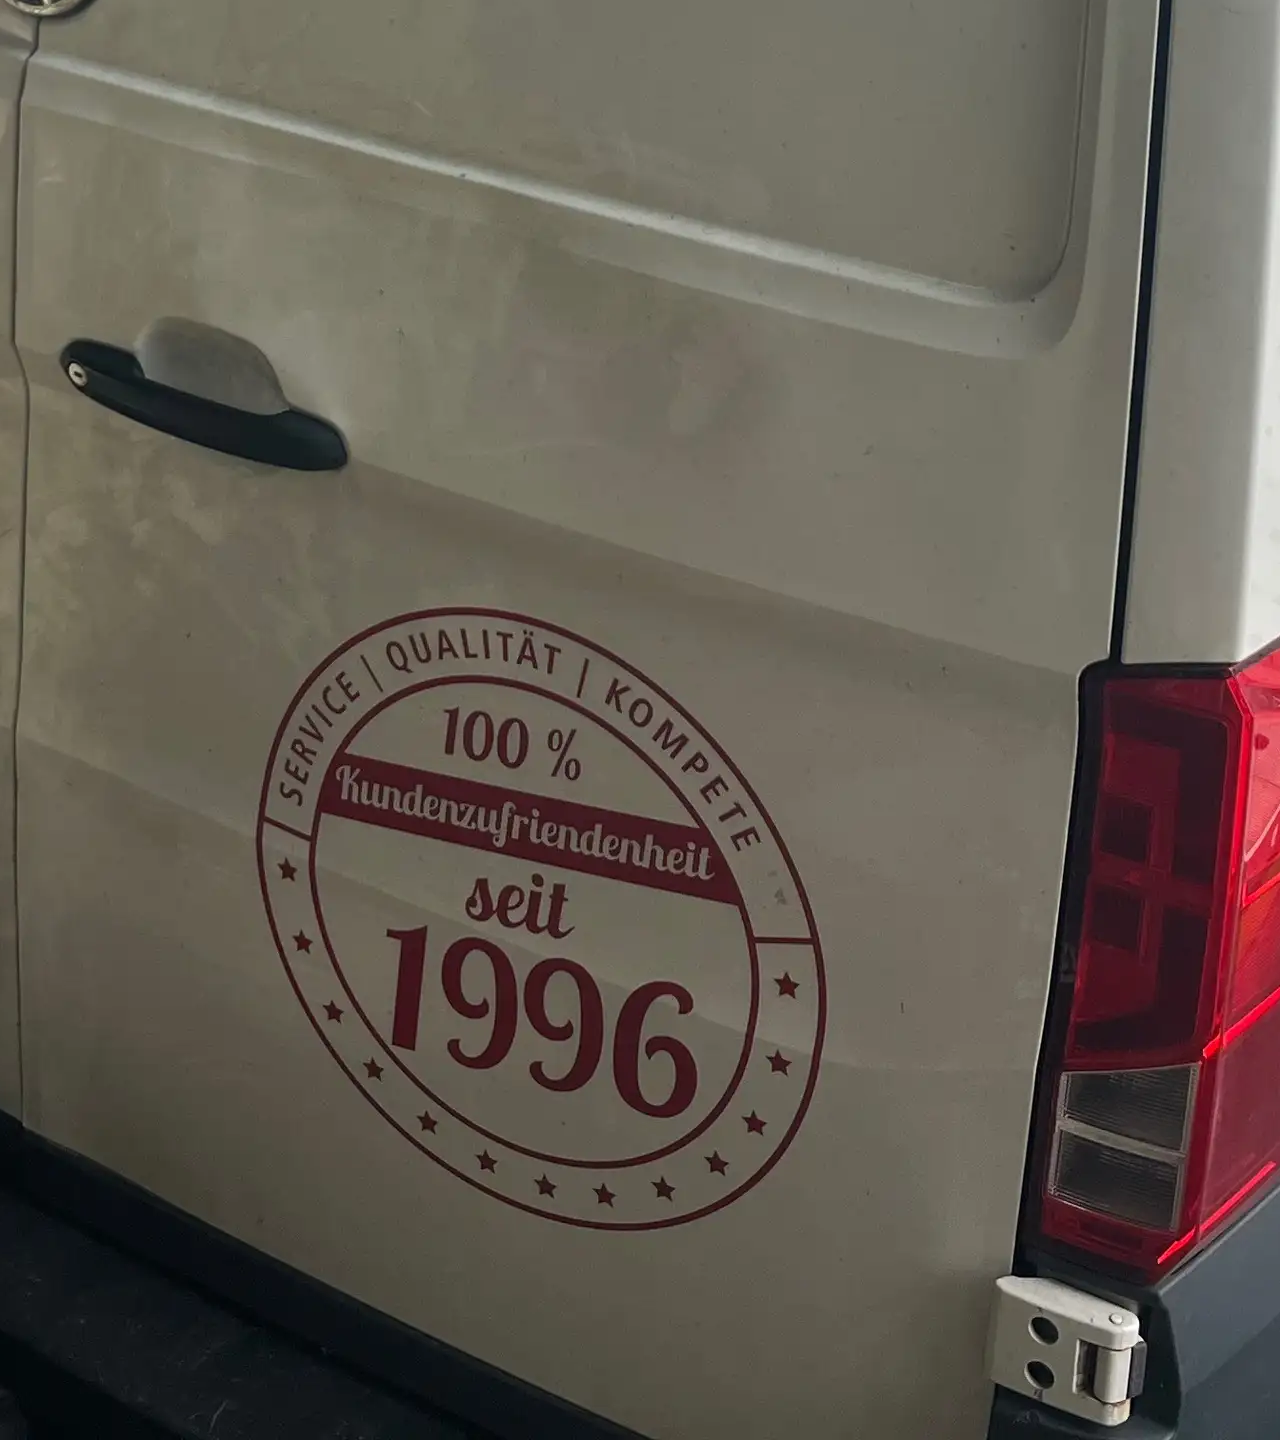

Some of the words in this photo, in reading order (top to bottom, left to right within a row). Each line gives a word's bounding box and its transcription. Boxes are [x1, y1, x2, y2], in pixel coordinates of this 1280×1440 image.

[280, 671, 361, 807] SERVICE
[385, 628, 562, 676] QUALITÄT
[605, 677, 762, 853] KOMPETE
[442, 706, 531, 770] 100
[546, 727, 582, 782] %
[335, 764, 717, 881] Kundenzufriendenheit
[464, 873, 576, 940] seit
[385, 925, 699, 1120] 1996
